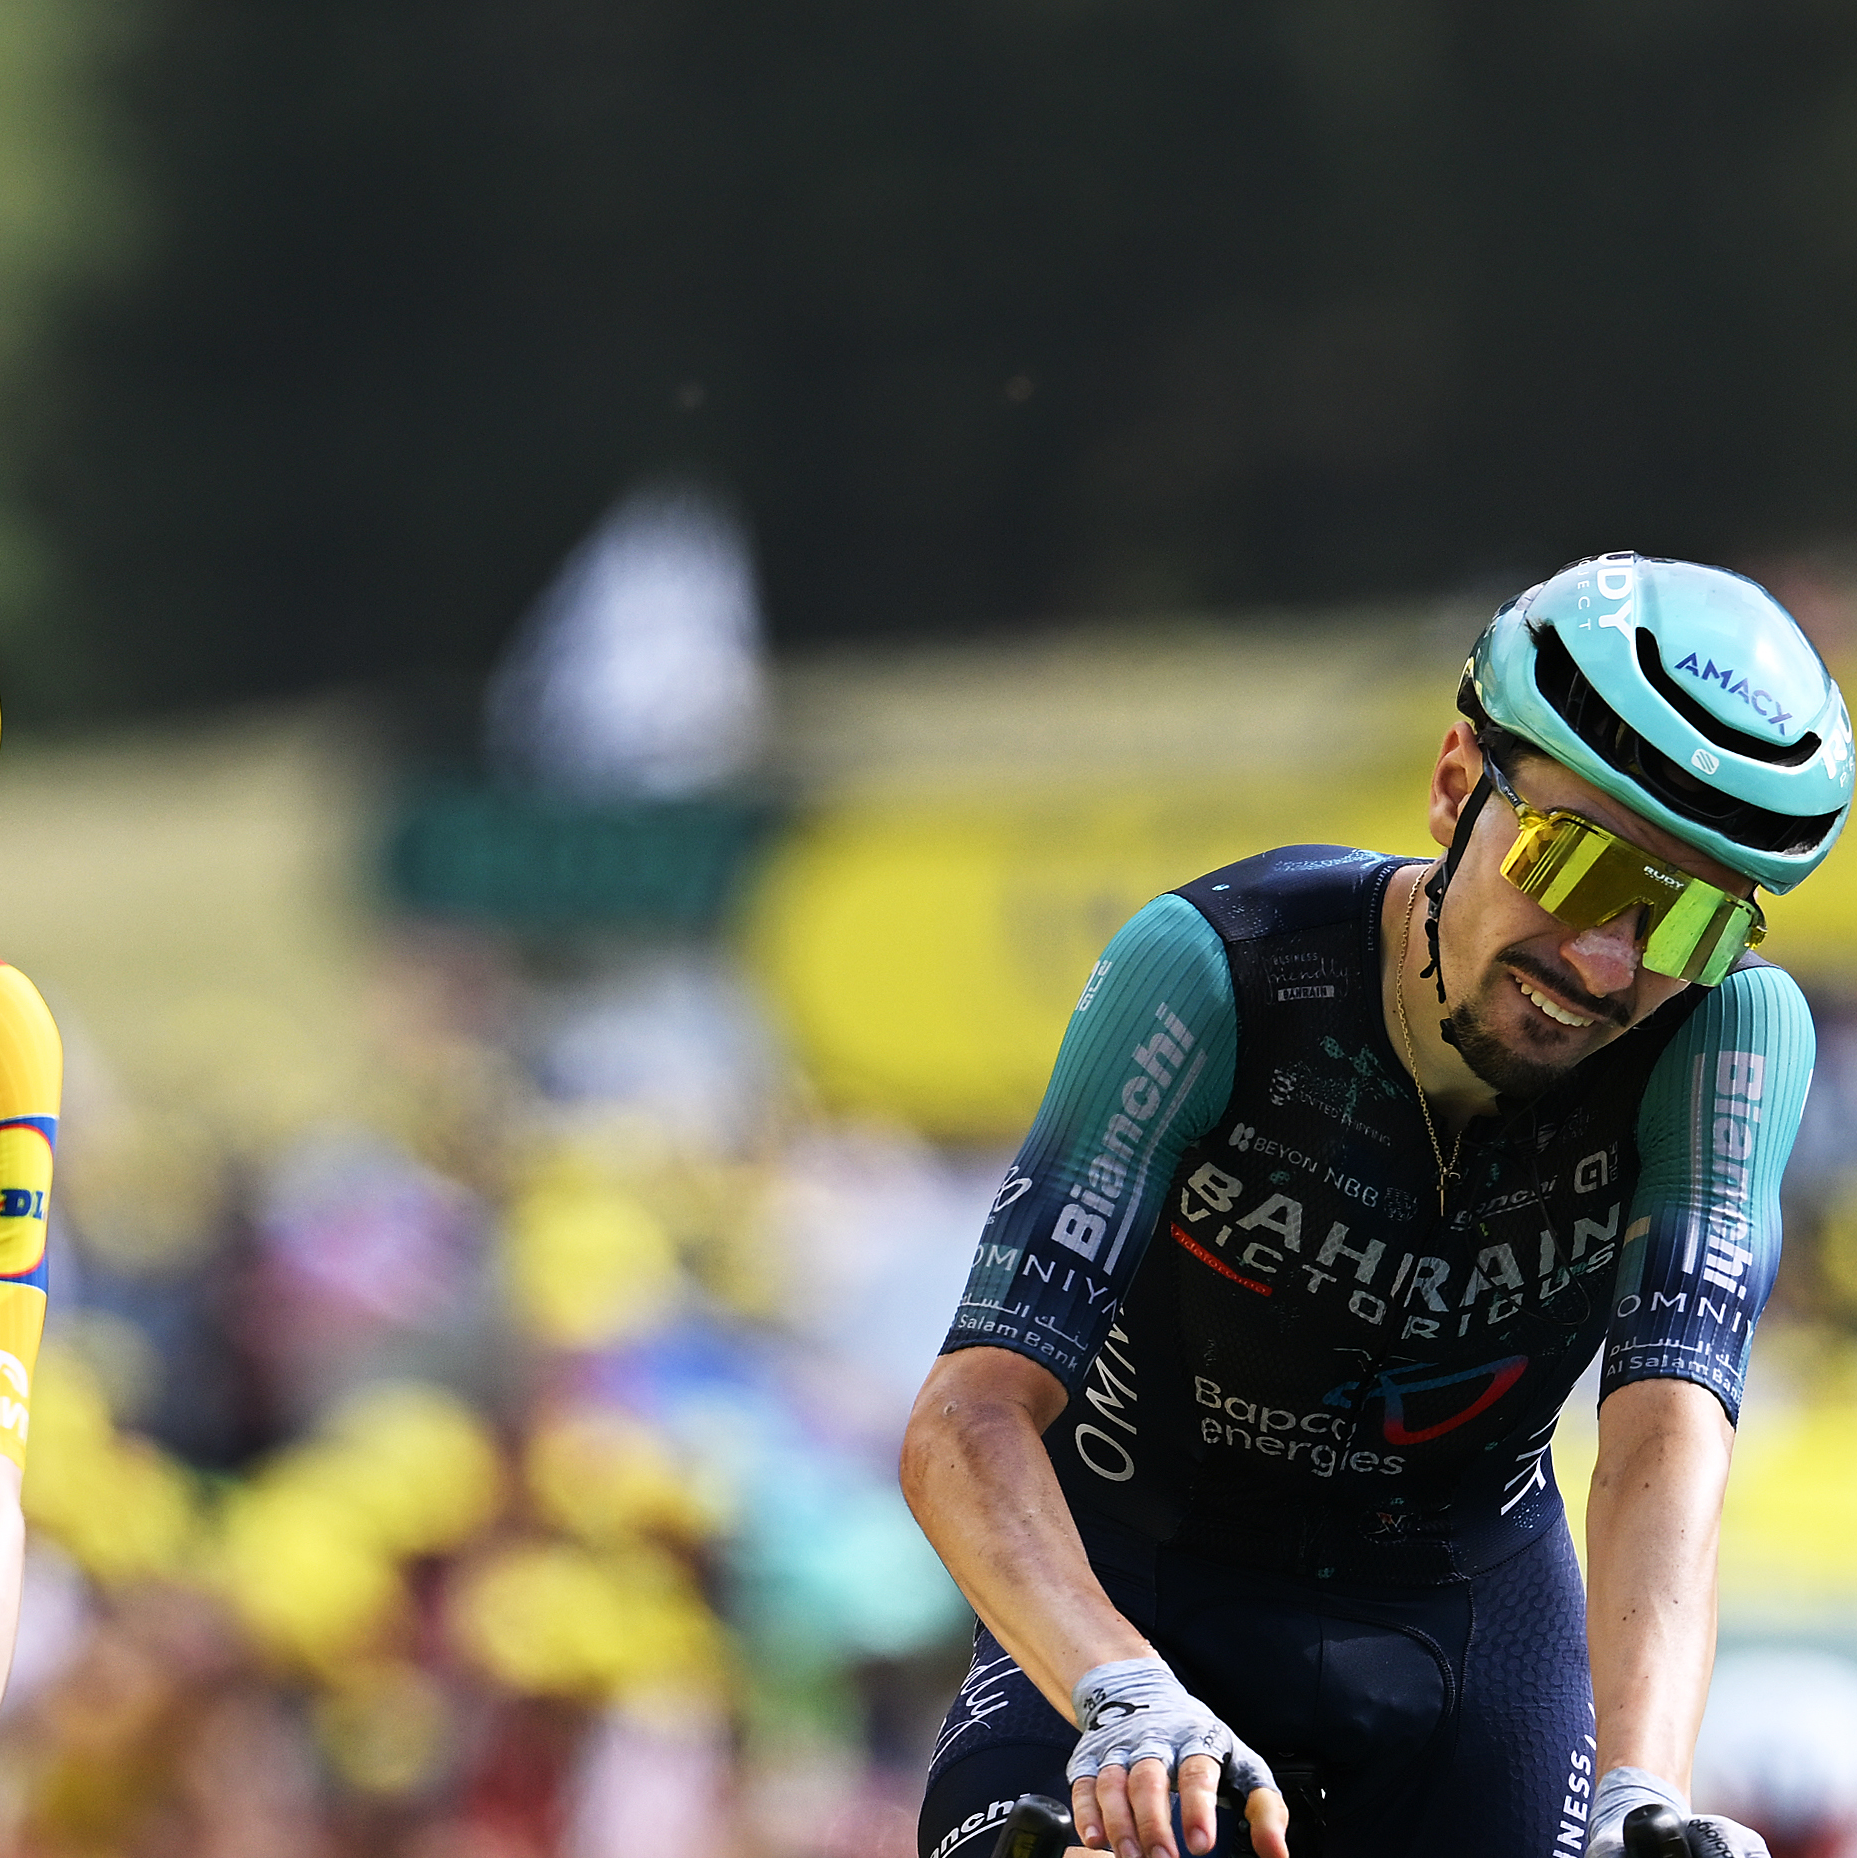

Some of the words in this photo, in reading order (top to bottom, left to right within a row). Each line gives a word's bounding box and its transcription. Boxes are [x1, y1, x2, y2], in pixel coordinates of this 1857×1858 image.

[1597, 550, 1636, 645] UDY
[1673, 651, 1793, 736] AMACX
[1643, 865, 1685, 890] RUDY
[1283, 986, 1327, 1000] BAHRAIN
[1051, 1001, 1195, 1263] Bianchi
[1253, 1136, 1318, 1174] BEYON
[1323, 1166, 1380, 1208] NBB
[1703, 1050, 1766, 1301] Bianchi
[1180, 1186, 1615, 1340] VICTORIOUS
[1187, 1160, 1621, 1314] BAHRAIN
[957, 1313, 1019, 1339] Salam
[1024, 1330, 1079, 1373] Bank
[1606, 1360, 1623, 1379] Al
[1629, 1354, 1709, 1376] Salam
[1194, 1376, 1358, 1441] Bapco
[1199, 1417, 1406, 1478] energies
